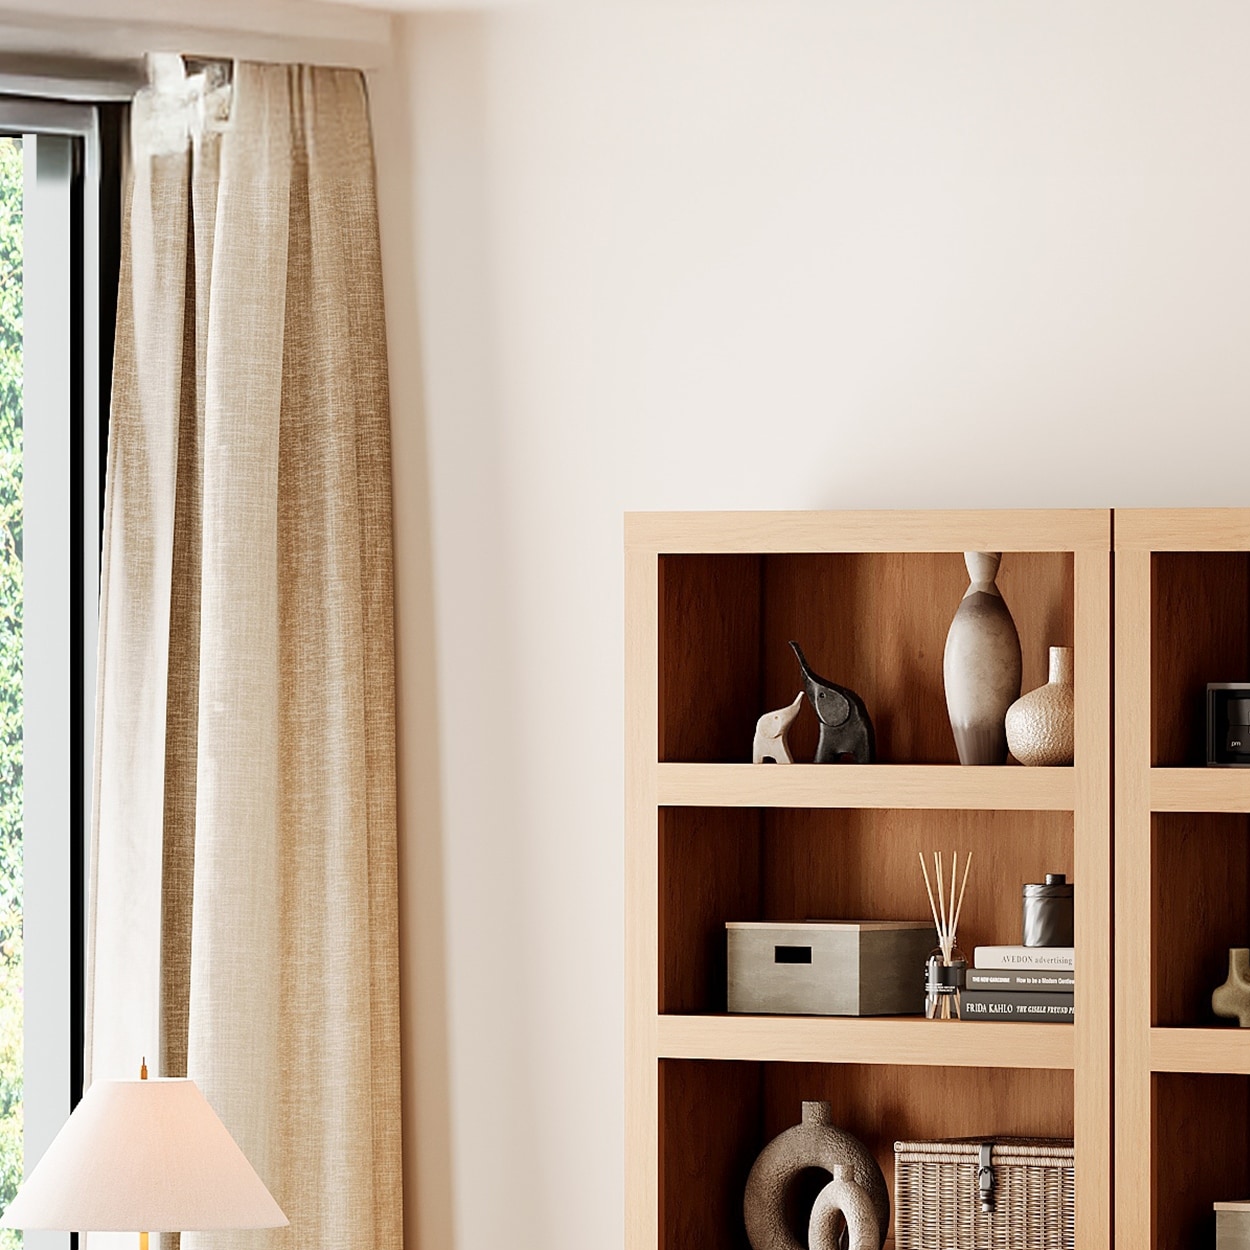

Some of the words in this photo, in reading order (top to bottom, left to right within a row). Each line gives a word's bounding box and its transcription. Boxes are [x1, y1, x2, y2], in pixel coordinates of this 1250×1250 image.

[1001, 955, 1033, 964] AVEDON
[1035, 956, 1073, 966] advertising
[966, 1003, 987, 1013] FRIDA
[988, 1003, 1013, 1014] KAHLO
[1016, 1005, 1027, 1013] THE
[1028, 1005, 1046, 1014] GISELE
